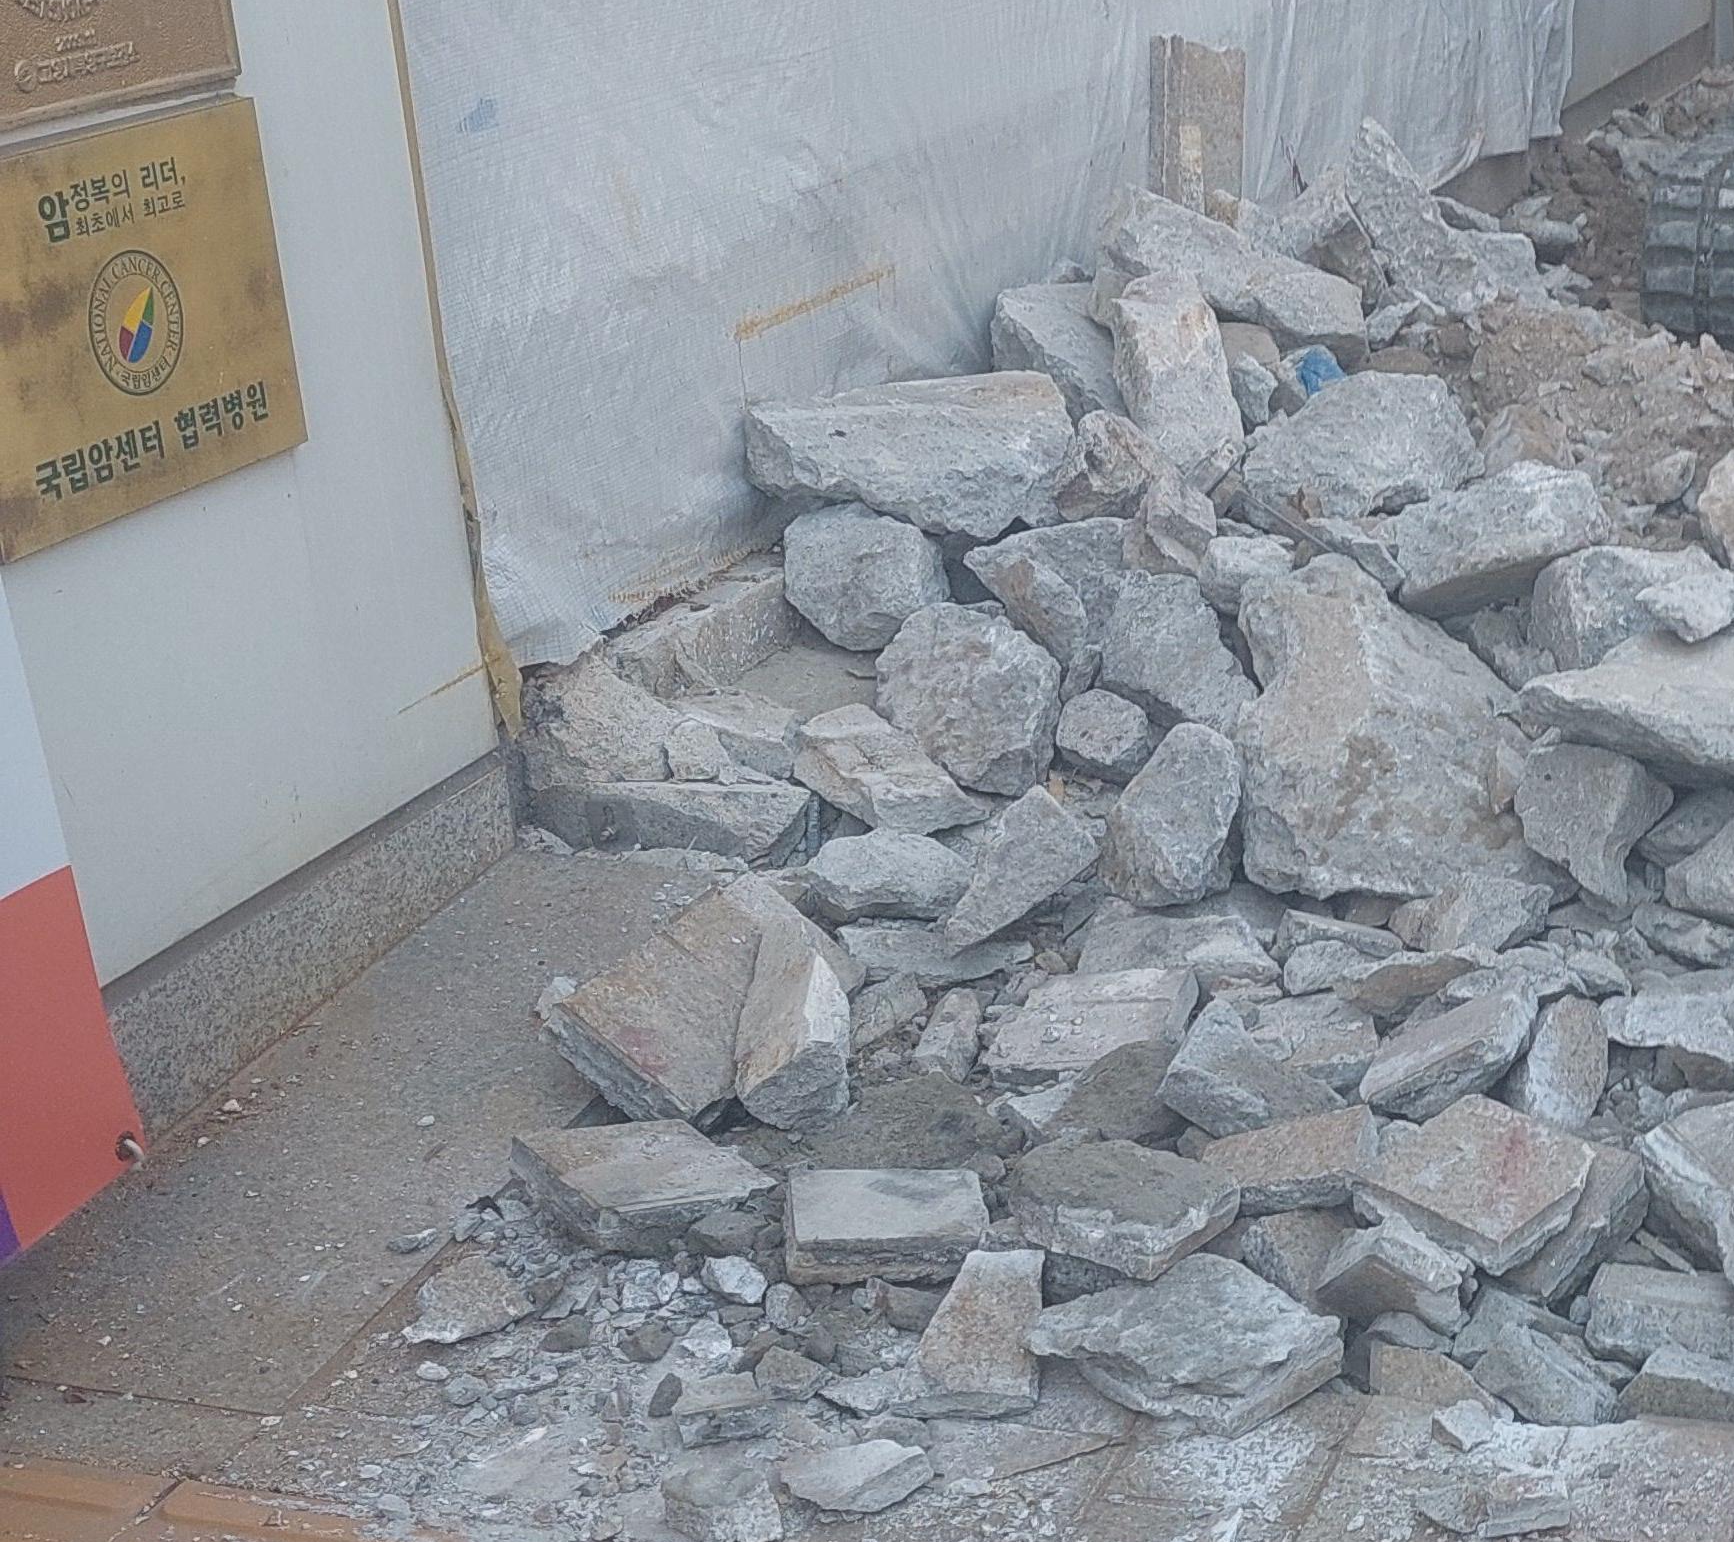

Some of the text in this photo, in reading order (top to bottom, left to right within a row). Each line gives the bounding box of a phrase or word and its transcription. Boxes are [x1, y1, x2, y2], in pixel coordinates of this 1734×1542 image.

[70, 168, 131, 213] 정복의
[75, 190, 186, 238] 최초에서 최고로
[93, 255, 180, 373] NATIONAL CANCER CENTER
[35, 380, 270, 502] 국립암센터 협력병원
